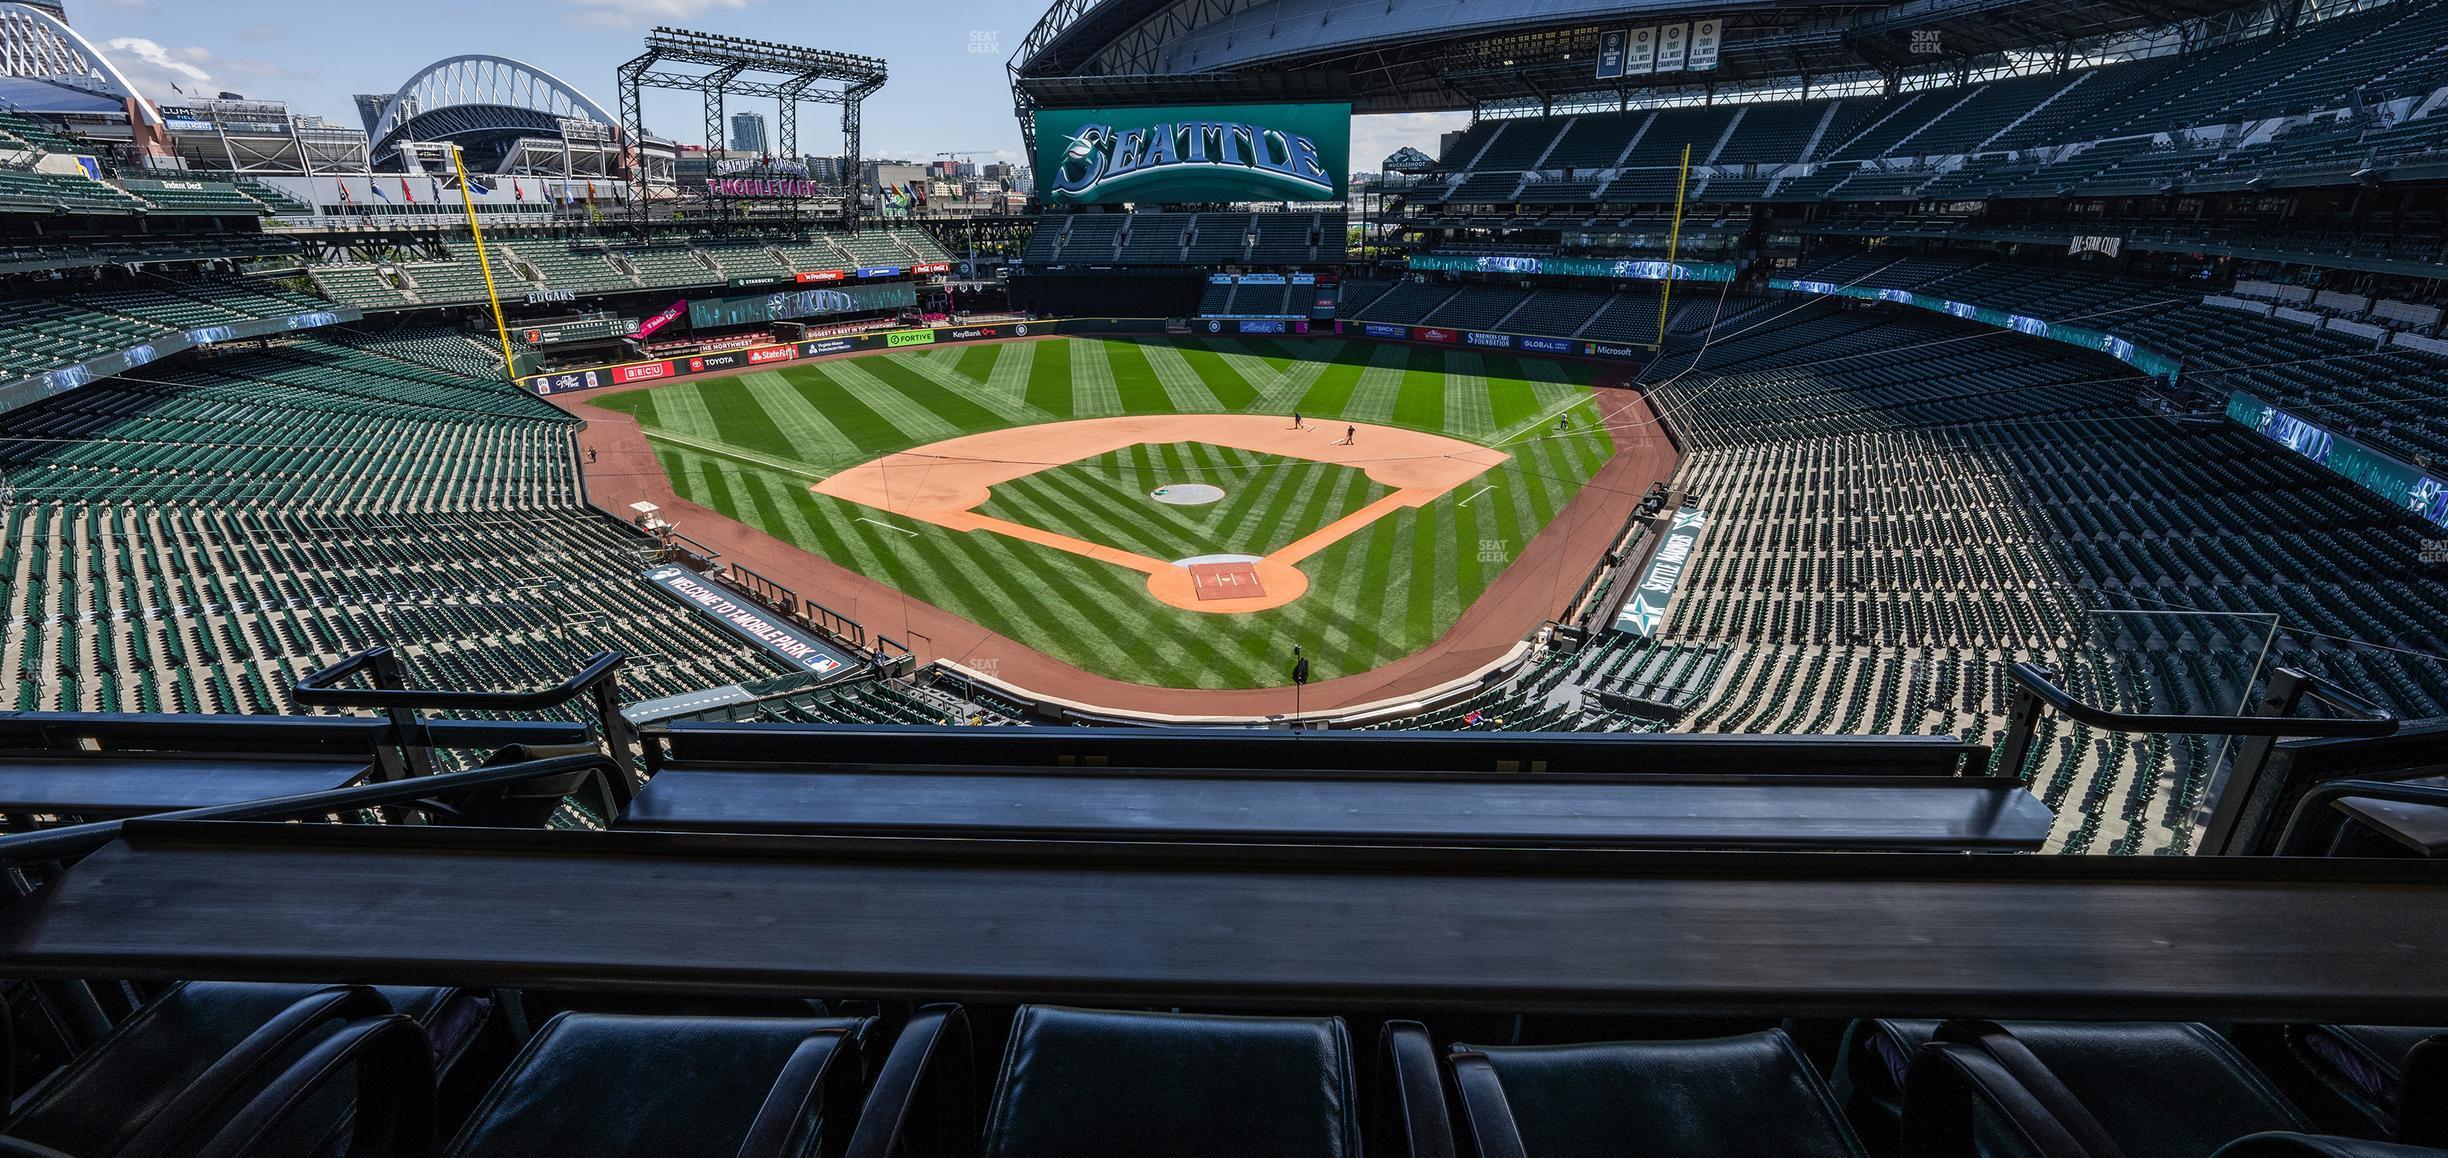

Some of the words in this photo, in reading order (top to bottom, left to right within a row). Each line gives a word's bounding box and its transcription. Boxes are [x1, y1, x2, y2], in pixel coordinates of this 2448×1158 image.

[1702, 47, 1715, 55] WEST
[1658, 59, 1683, 67] CHAMPIONS
[1690, 56, 1716, 64] CHAMPIONS
[1628, 63, 1652, 71] CHAMPIONS
[162, 107, 197, 115] LUM
[1051, 120, 1334, 200] SEATTLE
[161, 181, 186, 190] Trident
[186, 182, 203, 190] Deck
[705, 178, 778, 197] T-MOBILE
[780, 179, 819, 197] PARK
[2101, 236, 2120, 258] CLUB
[745, 277, 774, 285] STARBUCKS
[1241, 322, 1273, 333] Alaska
[808, 330, 831, 338] BIGGEST
[900, 333, 931, 342] FORTIVE
[953, 330, 981, 338] KeyBank
[1475, 333, 1498, 341] MARINERS
[713, 340, 752, 350] NORTHWEST
[1475, 338, 1509, 347] FOUNDATION
[1524, 340, 1554, 349] GLOBAL
[1597, 345, 1632, 356] Microsoft
[704, 356, 734, 366] TOYOTA
[628, 365, 660, 378] BECU
[1640, 562, 1680, 594] SEATTLE
[667, 576, 724, 608] WELCOME
[711, 600, 737, 615] TO
[726, 608, 780, 643] T-MOBILE
[772, 631, 817, 659] PARK
